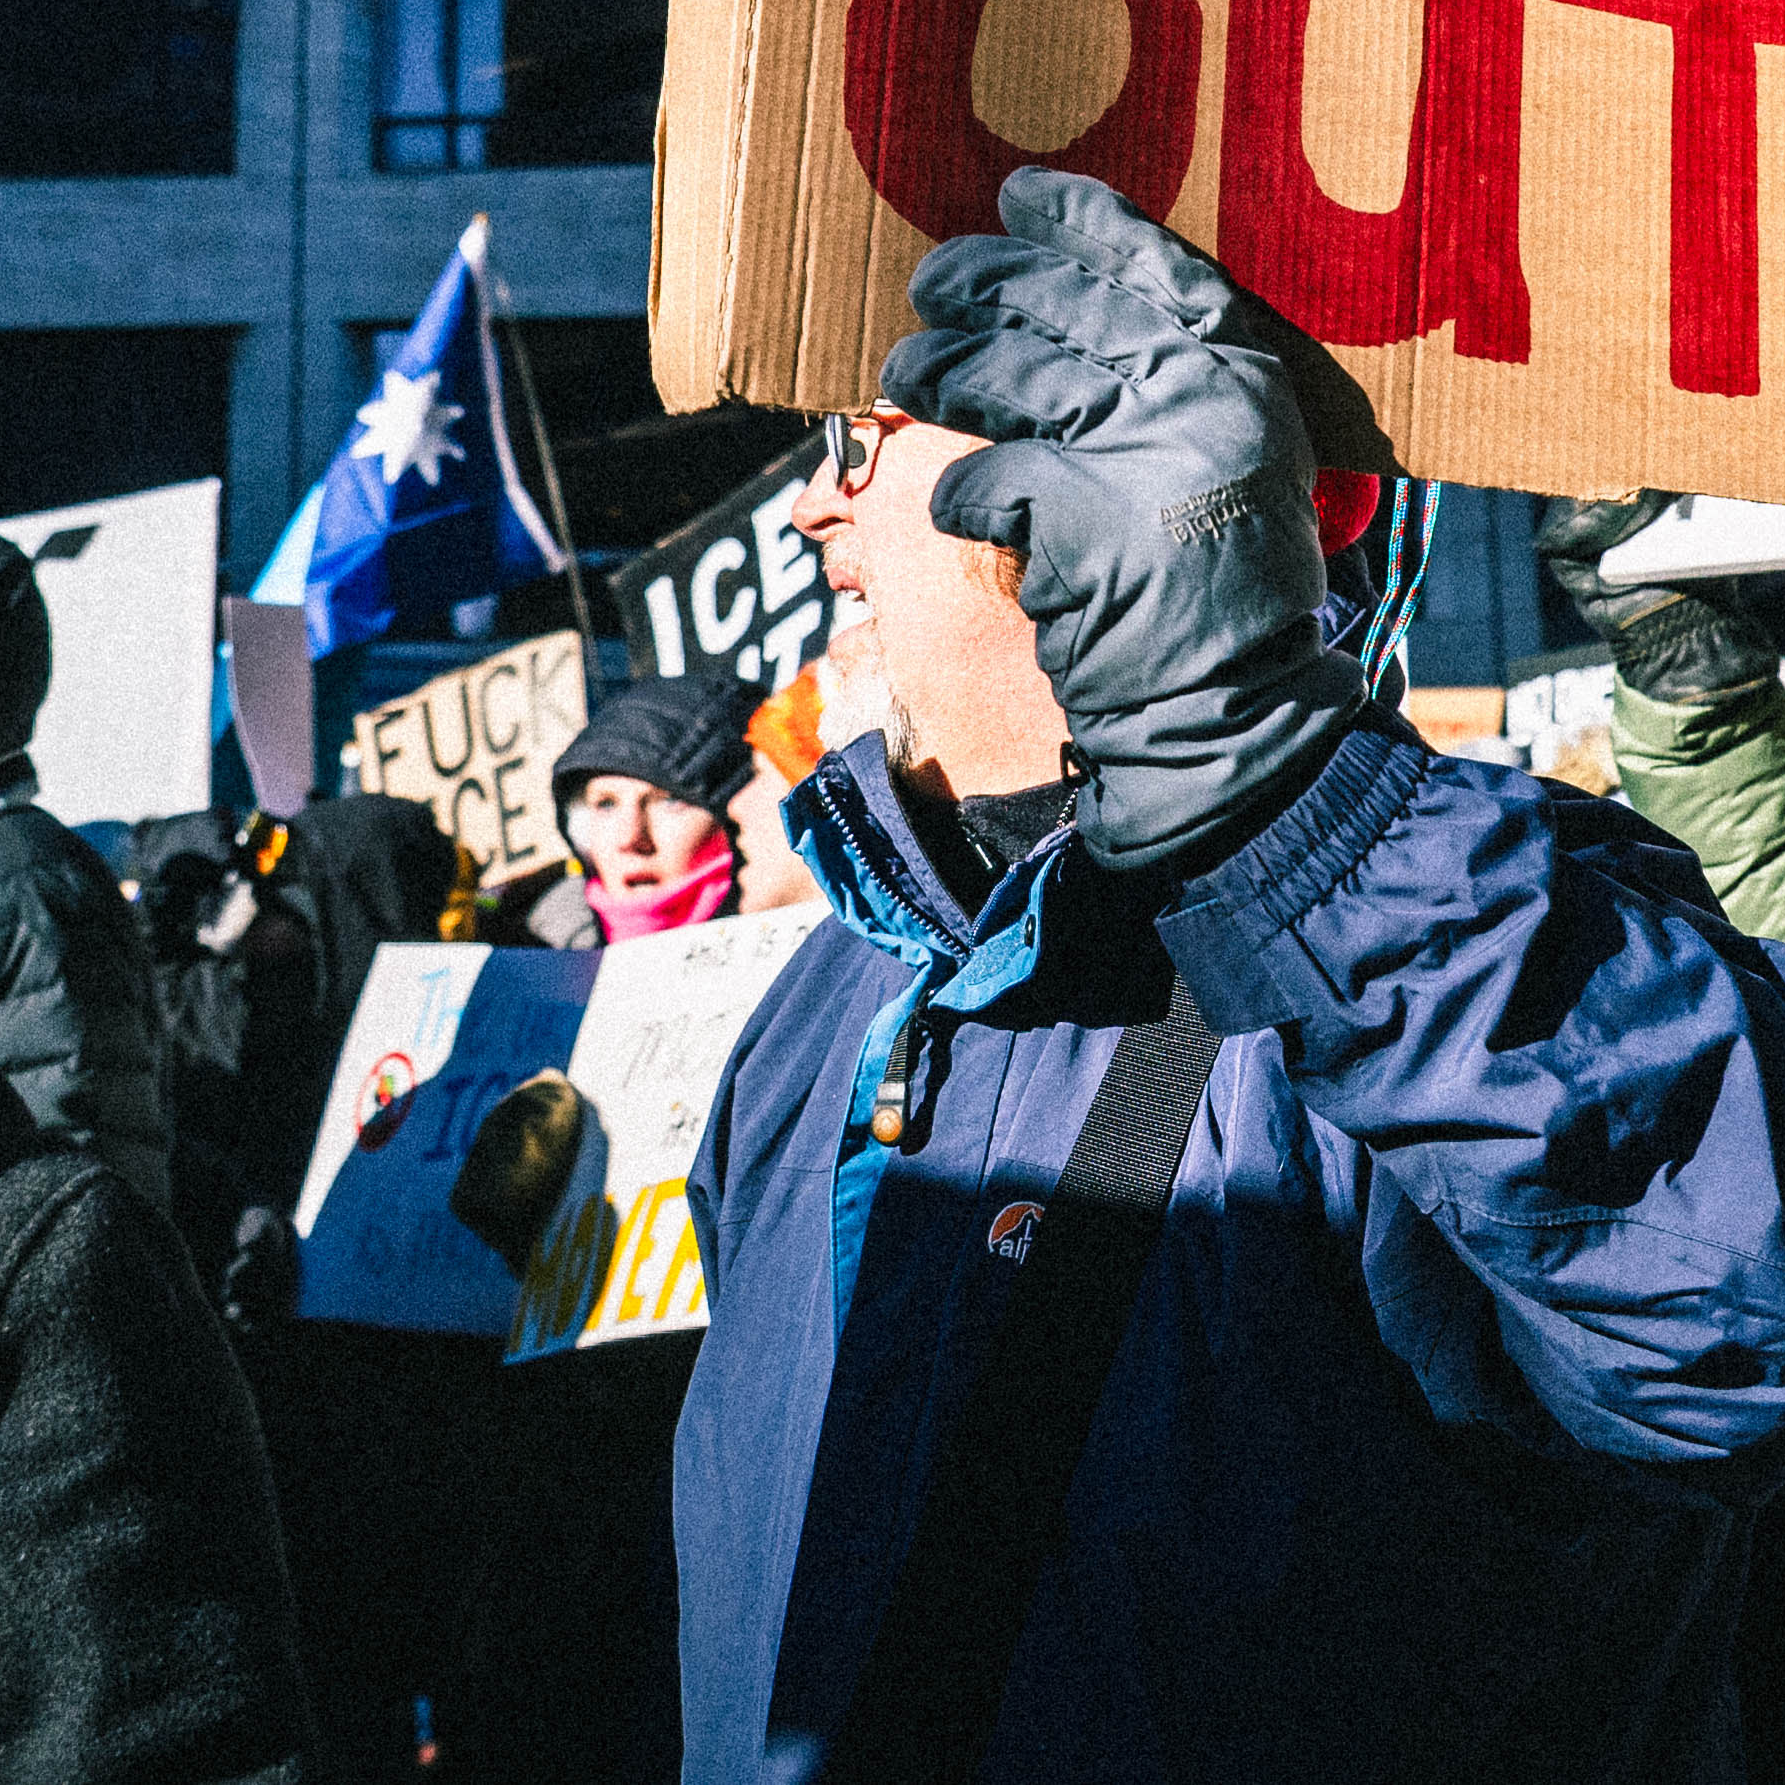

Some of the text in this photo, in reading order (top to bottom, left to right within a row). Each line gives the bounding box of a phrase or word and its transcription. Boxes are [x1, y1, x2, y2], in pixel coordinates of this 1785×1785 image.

[644, 478, 817, 678] ICE
[373, 648, 576, 792] FUCK
[426, 757, 537, 874] CE
